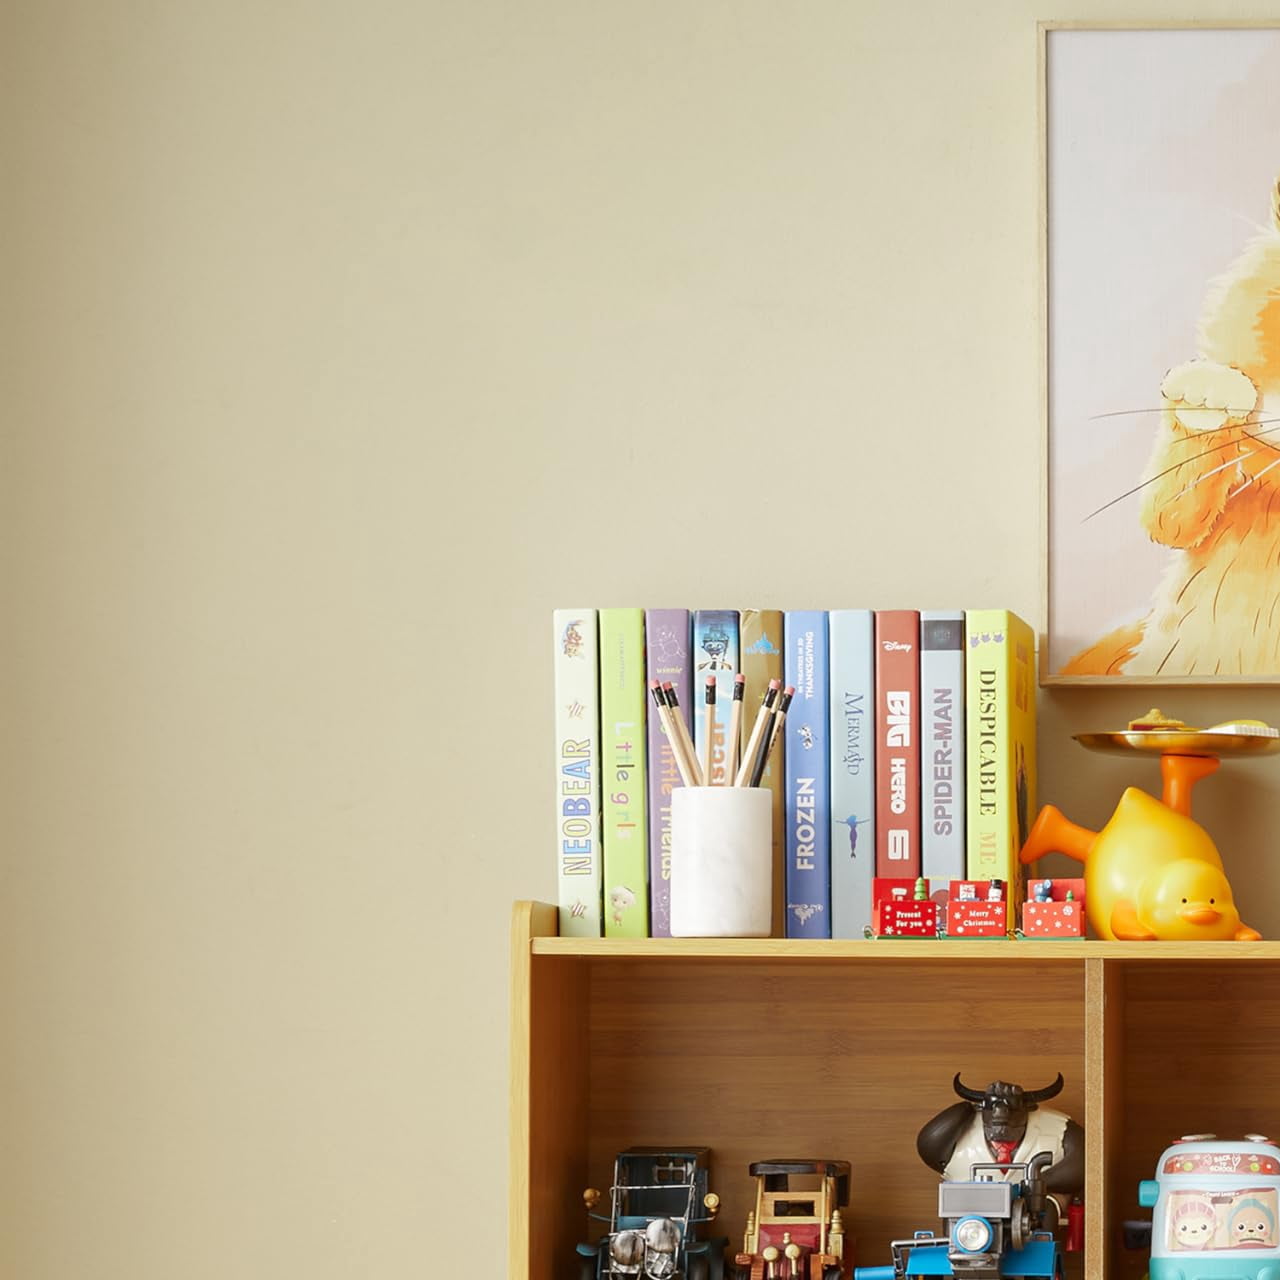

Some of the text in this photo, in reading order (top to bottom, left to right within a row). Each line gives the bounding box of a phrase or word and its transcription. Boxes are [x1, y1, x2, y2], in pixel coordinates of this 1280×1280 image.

[614, 721, 636, 782] Lttle
[886, 691, 911, 747] BIG
[933, 688, 953, 836] SPIDER-MAN
[561, 738, 592, 876] NEOBEAR
[890, 758, 906, 814] HERO
[979, 670, 996, 864] DESPICABLE ME
[796, 777, 816, 870] FROZEN
